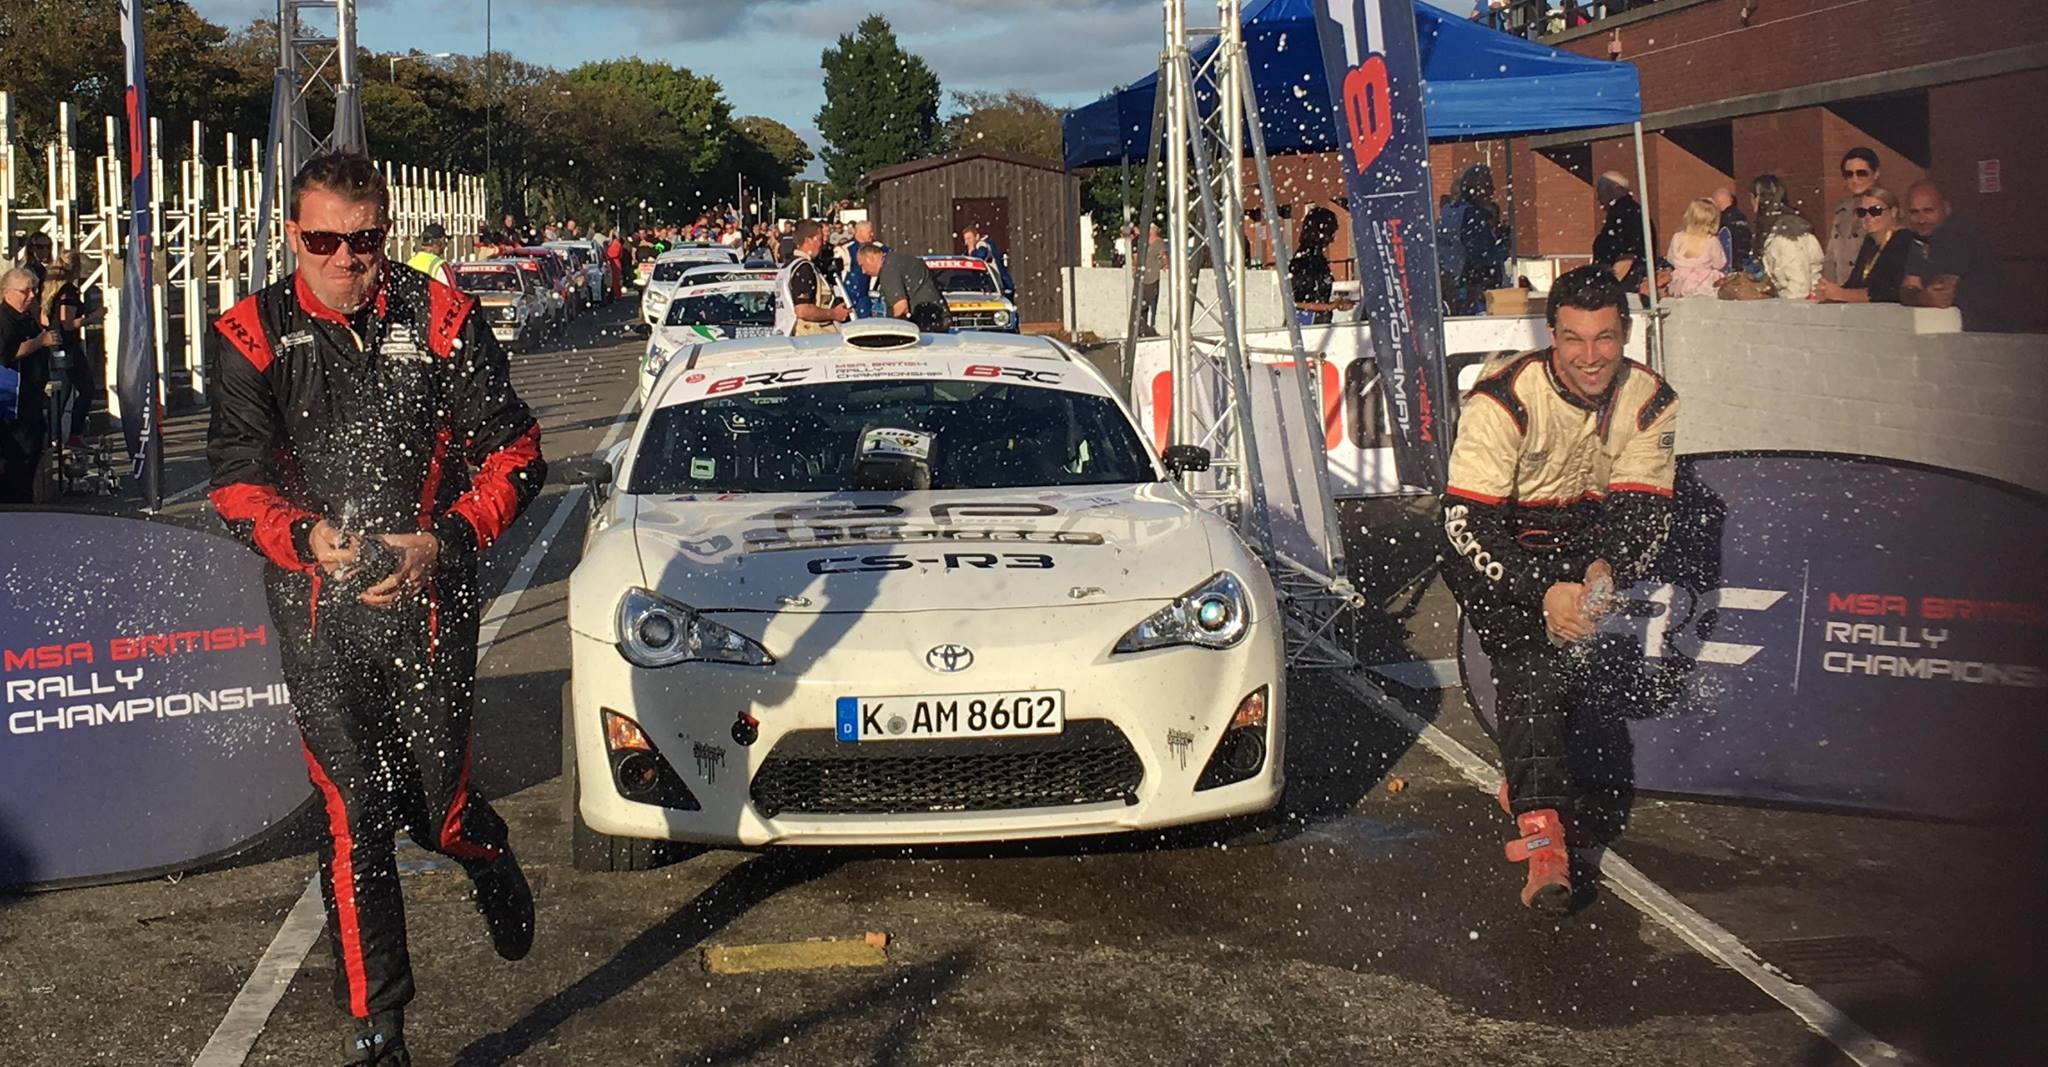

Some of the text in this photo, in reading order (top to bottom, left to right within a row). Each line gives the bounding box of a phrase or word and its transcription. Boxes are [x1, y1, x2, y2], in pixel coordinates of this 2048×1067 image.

[225, 317, 261, 352] HRX
[706, 367, 813, 394] BRC
[963, 364, 1064, 385] BRC
[807, 553, 1055, 575] CS-R3
[1827, 591, 1906, 616] MSA
[4, 624, 268, 672] MSA BRITISH
[1823, 621, 1948, 648] RALLY
[6, 667, 144, 704] RALLY
[843, 723, 853, 734] D
[862, 696, 1056, 735] K AM 8602
